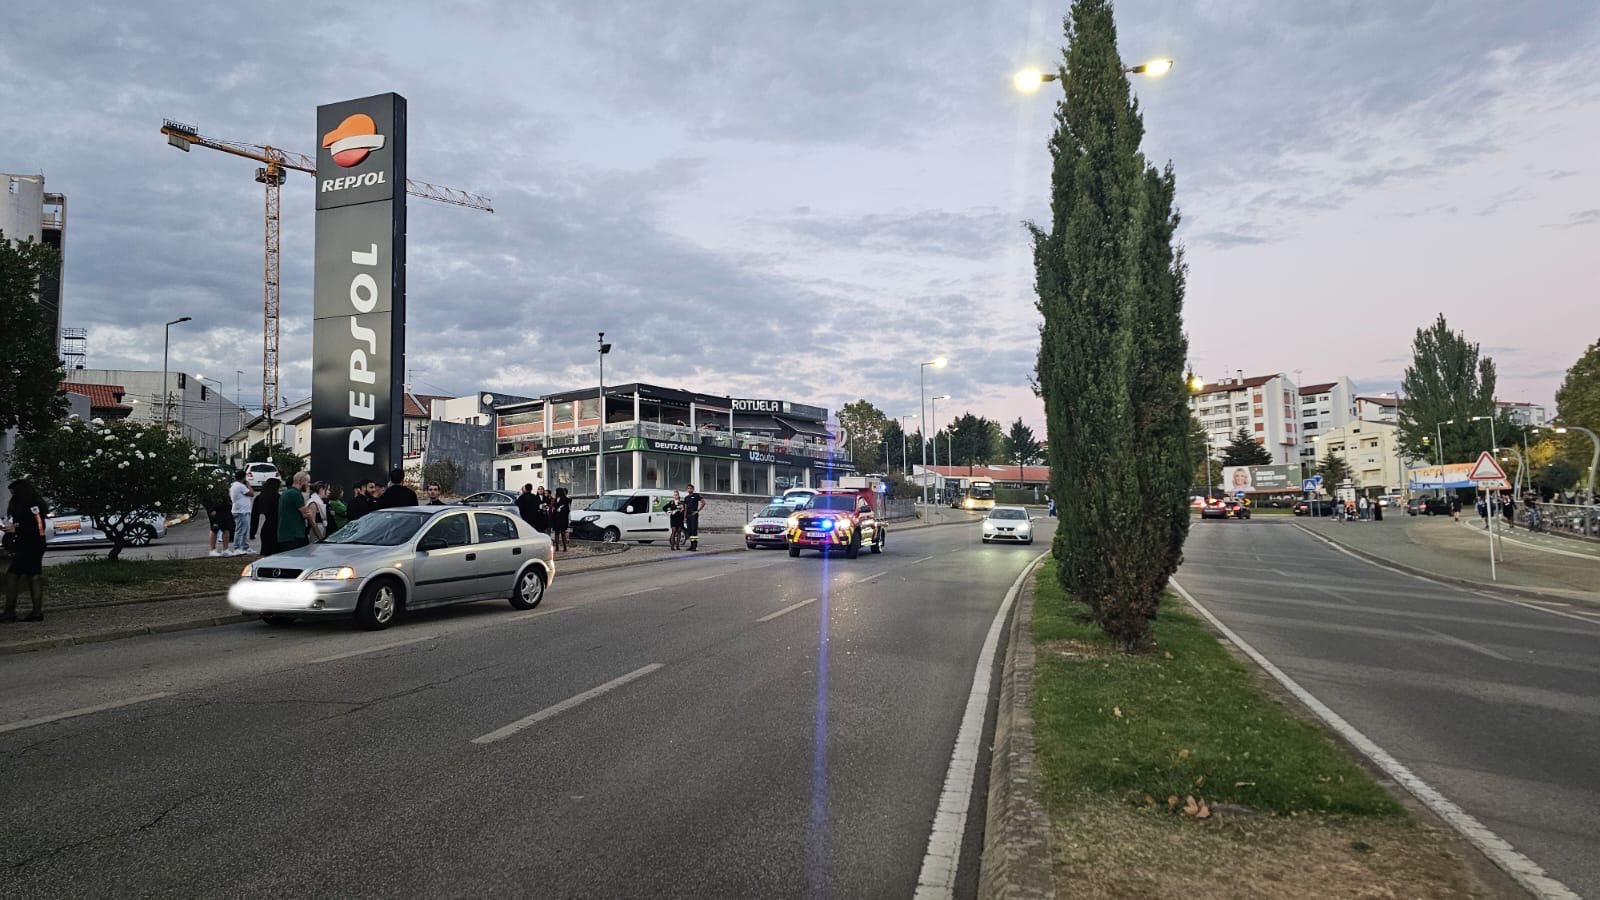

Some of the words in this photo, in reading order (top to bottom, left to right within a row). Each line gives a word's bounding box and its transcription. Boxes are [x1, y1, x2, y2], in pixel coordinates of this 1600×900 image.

[321, 170, 386, 193] REPSOL
[348, 243, 379, 465] REPSOL
[731, 398, 779, 412] ROTUELA
[547, 445, 591, 456] DEUTZ-FAHR
[654, 442, 698, 453] DEUTZ-FAHR
